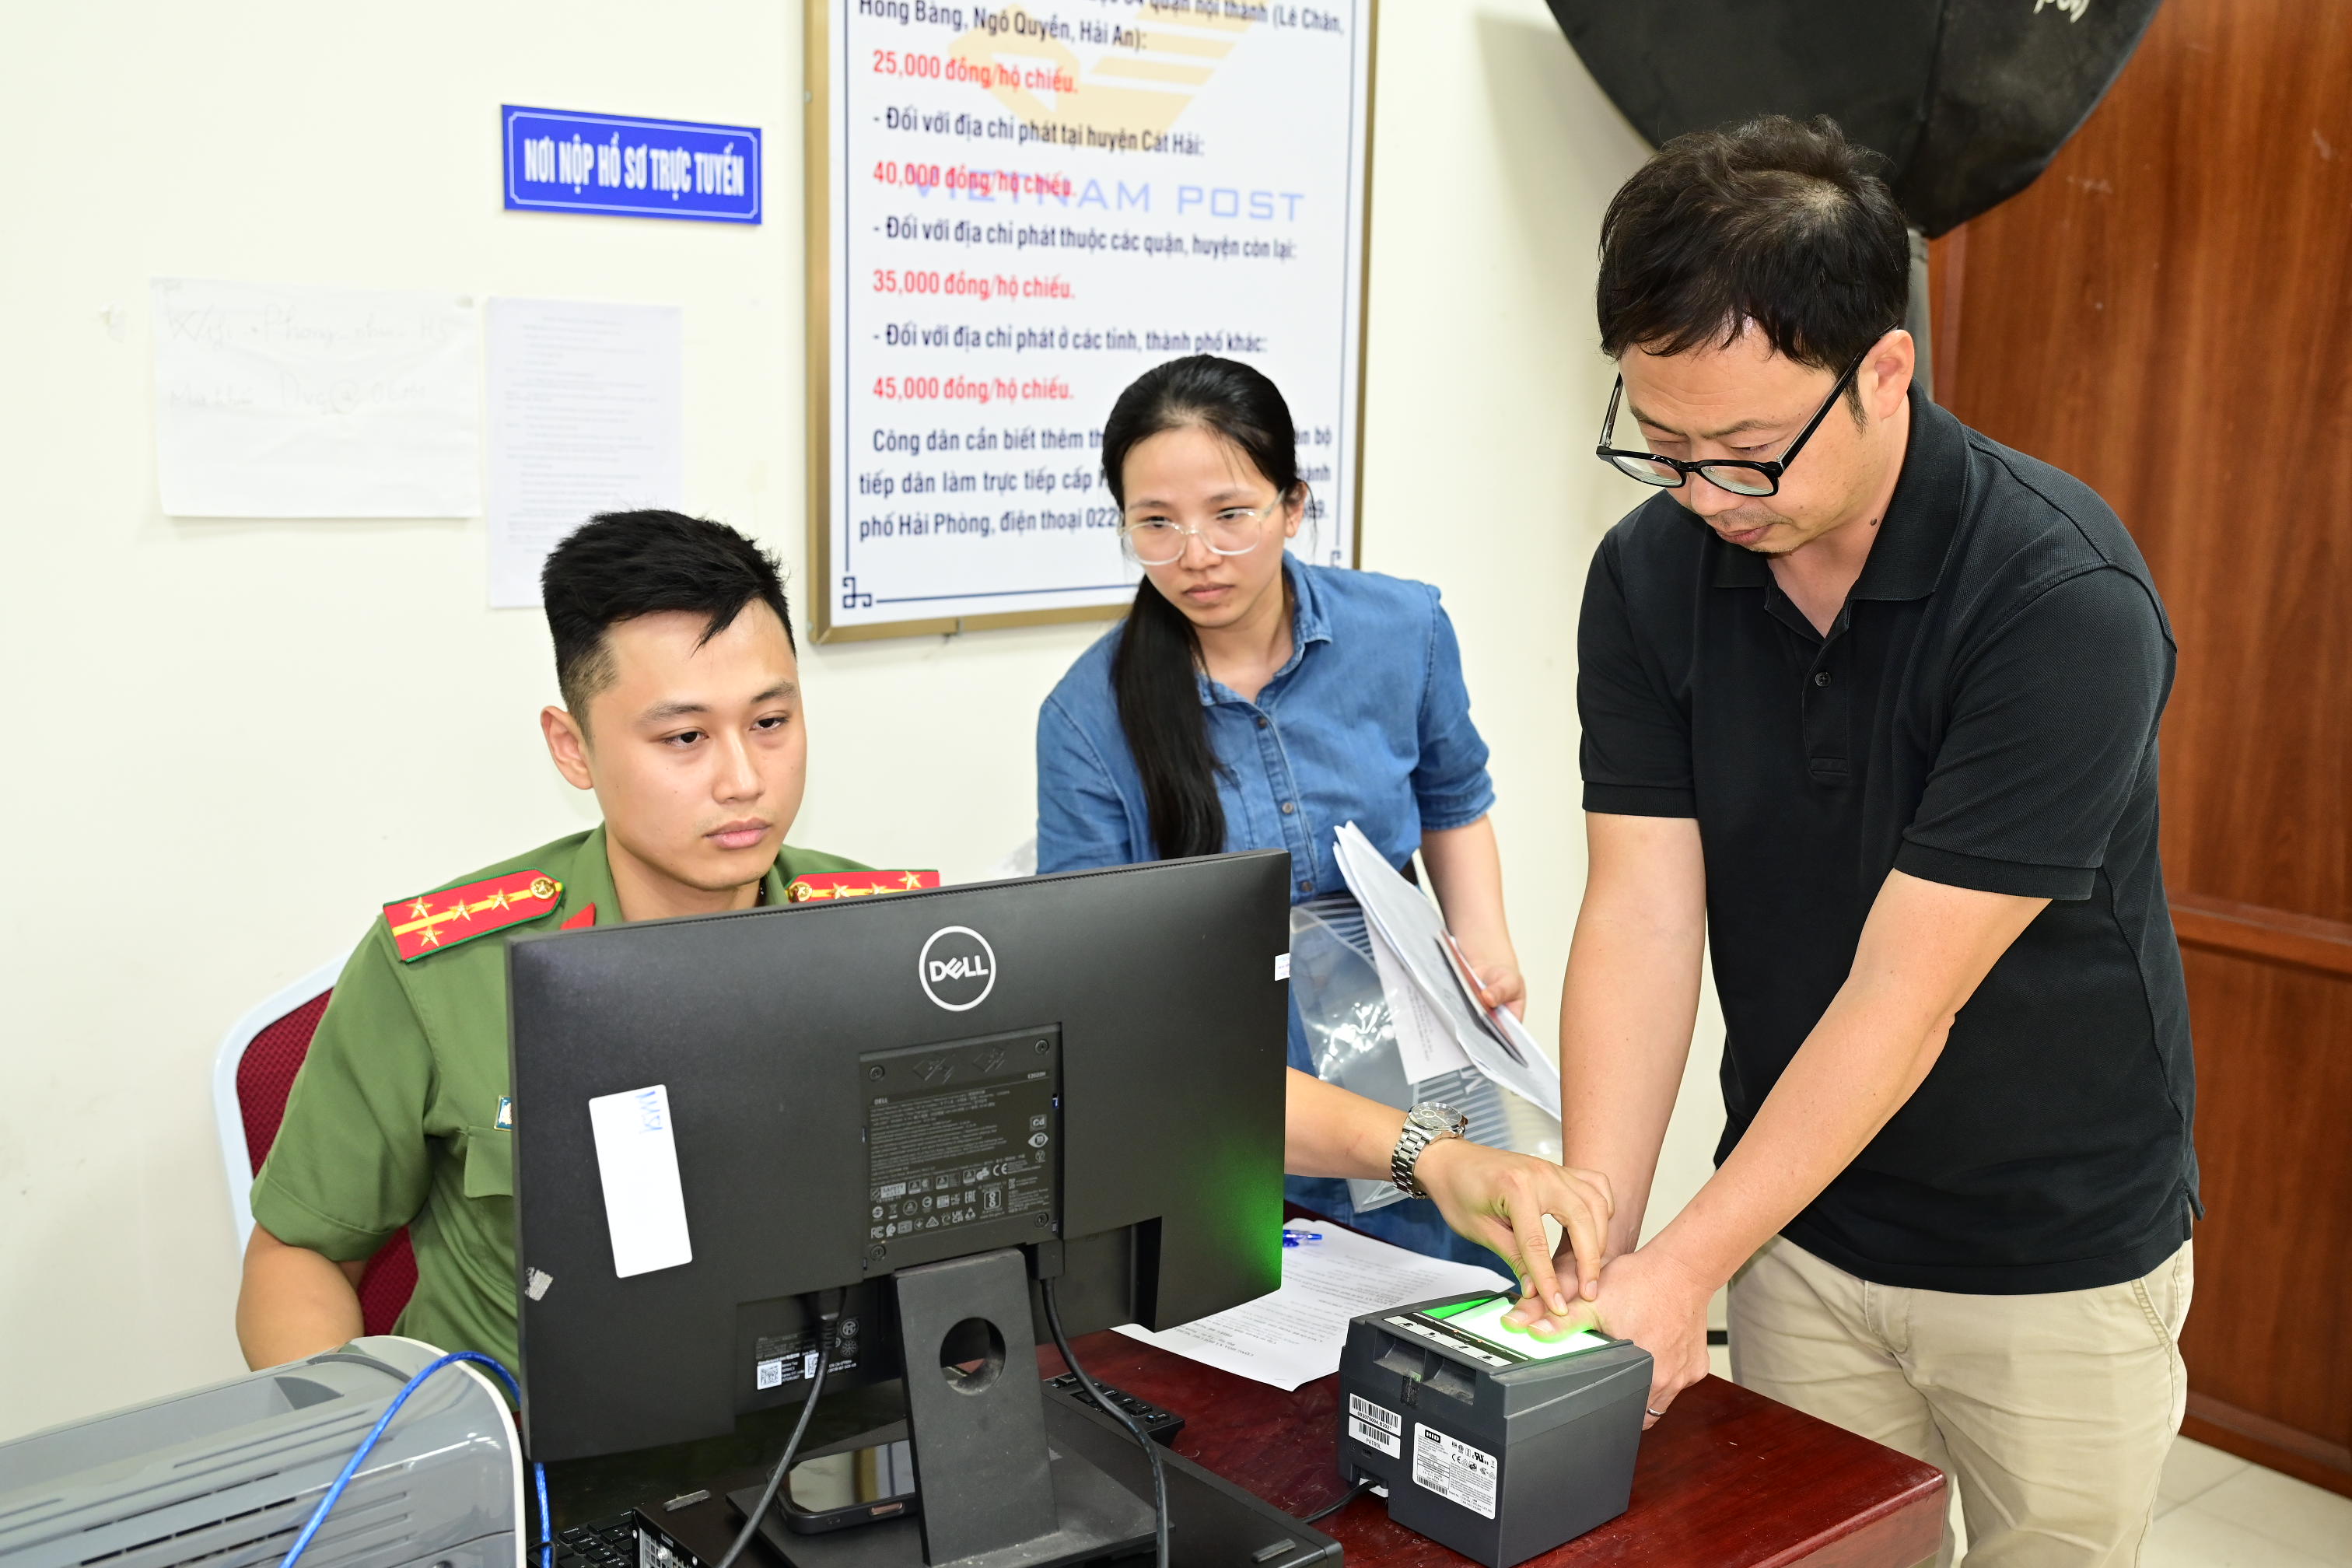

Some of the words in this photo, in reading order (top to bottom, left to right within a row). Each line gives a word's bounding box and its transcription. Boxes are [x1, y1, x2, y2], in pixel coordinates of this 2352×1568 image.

[1080, 19, 1108, 44] Hải
[1112, 25, 1146, 51] An):
[873, 50, 940, 79] 25,000
[1025, 66, 1079, 93] chiếu.
[886, 105, 918, 131] Đối
[922, 110, 950, 133] với
[955, 114, 982, 142] địa
[1018, 120, 1058, 146] phát
[1061, 122, 1083, 151] tại
[1087, 125, 1138, 156] huyện
[1142, 129, 1169, 153] Cát
[523, 135, 556, 183] NƠI
[558, 134, 595, 194] NỘP
[597, 131, 621, 188] HỒ
[624, 143, 648, 190] SƠ
[649, 146, 691, 201] TRỰC
[694, 142, 745, 197] TUYẾN
[873, 160, 940, 187] 40,000
[1178, 185, 1304, 222] POST
[886, 213, 918, 239] Đối
[922, 219, 950, 241] với
[954, 220, 982, 248] địa
[1017, 224, 1056, 250] phát
[1060, 226, 1106, 254] thuộc
[1111, 229, 1140, 252] các
[1192, 235, 1239, 260] huyện
[873, 270, 940, 295] 35,000
[1023, 275, 1076, 299] chiếu.
[886, 320, 917, 346] Đối
[922, 326, 949, 348] với
[954, 326, 981, 353] địa
[1017, 327, 1054, 353] phát
[1073, 327, 1102, 349] các
[1146, 329, 1191, 351] thành
[1195, 328, 1224, 355] phố
[873, 376, 940, 404] 45,000
[1021, 376, 1075, 400] chiếu.
[873, 429, 920, 456] Công
[926, 429, 960, 451] dân
[966, 426, 998, 450] cần
[1003, 425, 1036, 450] biết
[1041, 429, 1083, 449] thêm
[859, 469, 894, 499] tiếp
[902, 471, 935, 494] dân
[943, 470, 976, 493] làm
[984, 471, 1017, 495] trực
[1024, 466, 1055, 494] tiếp
[1062, 464, 1092, 493] cấp
[859, 512, 894, 543] phố
[898, 512, 929, 537] Hải
[934, 512, 996, 538] Phòng,
[999, 510, 1037, 536] điện
[1041, 509, 1082, 534] thoại
[929, 954, 989, 982] DELL
[1366, 1438, 1381, 1450] PATROL
[1426, 1431, 1440, 1442] HID
